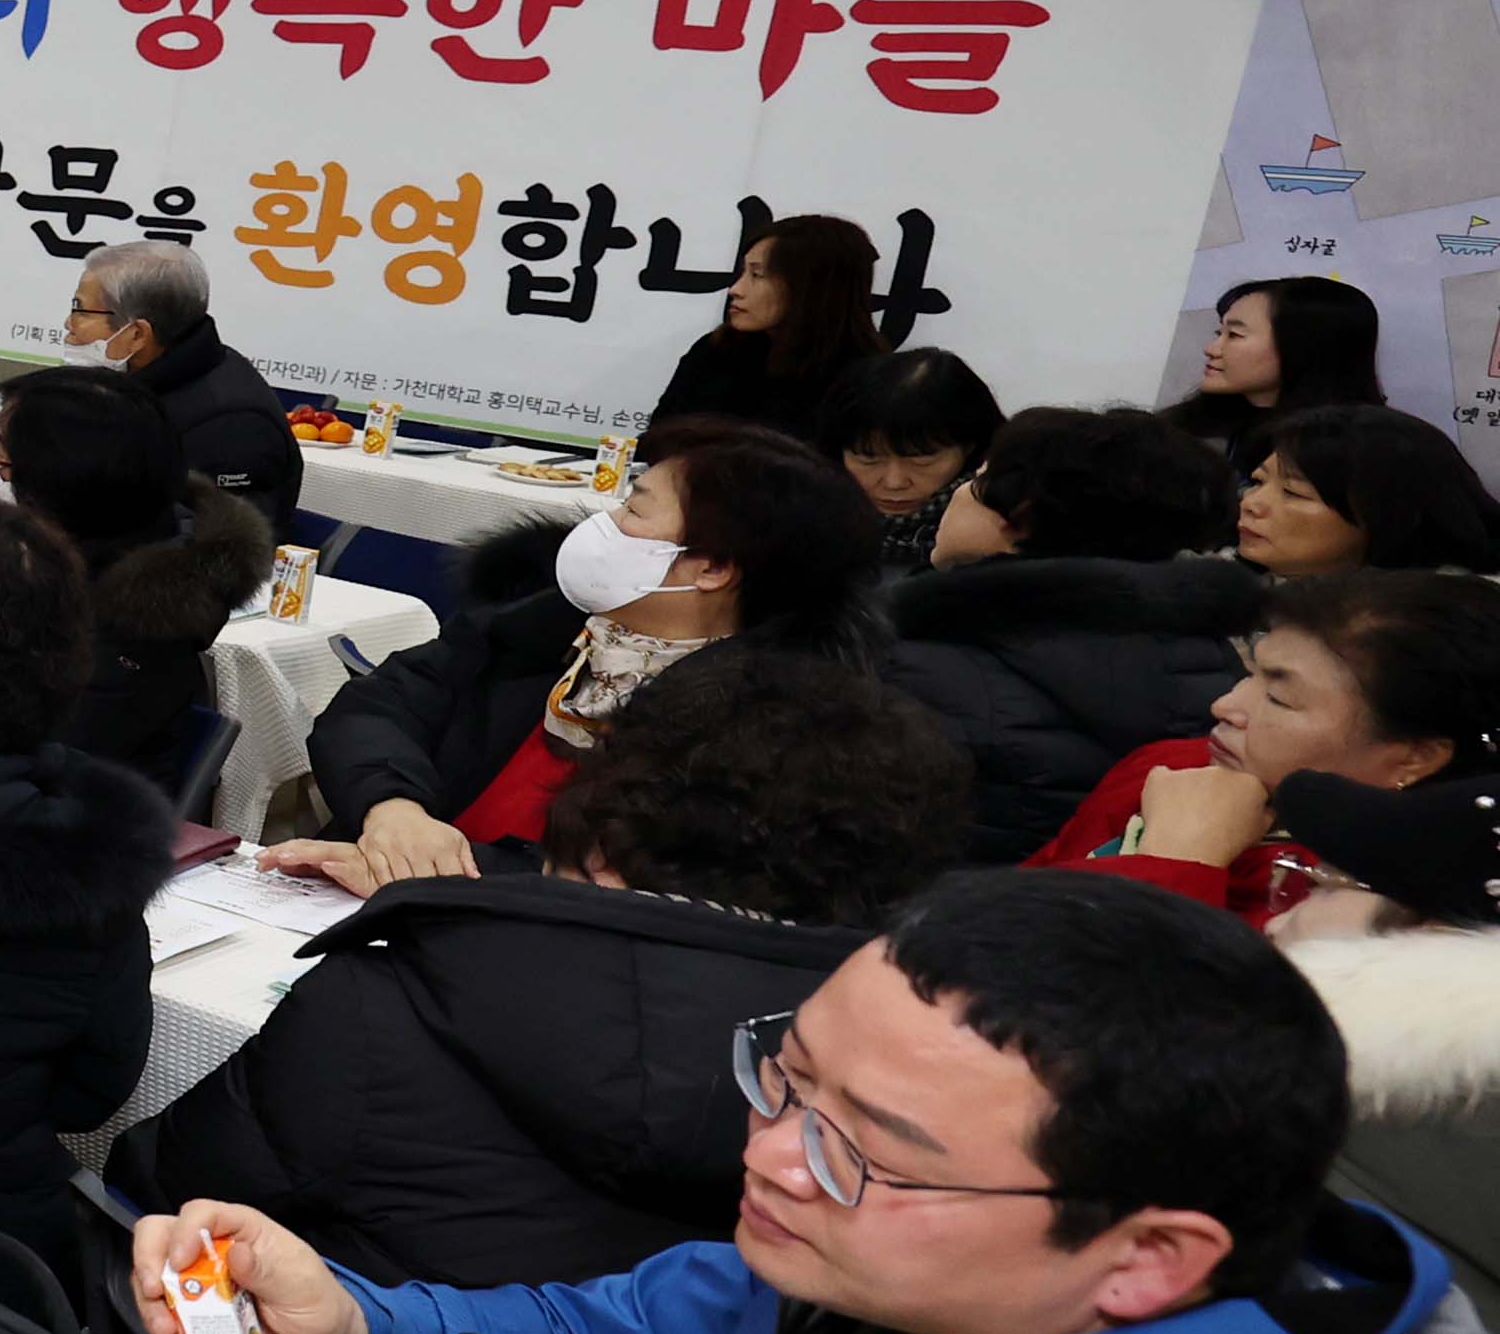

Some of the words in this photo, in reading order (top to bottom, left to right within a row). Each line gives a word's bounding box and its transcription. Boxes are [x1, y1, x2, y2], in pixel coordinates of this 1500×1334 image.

[1284, 234, 1338, 257] 십자굴
[11, 323, 45, 343] (기획
[48, 327, 63, 346] 및
[343, 370, 378, 391] 자문
[393, 377, 482, 406] 가천대학교
[486, 390, 606, 426] 홍의택교수님,
[1476, 388, 1500, 405] 대
